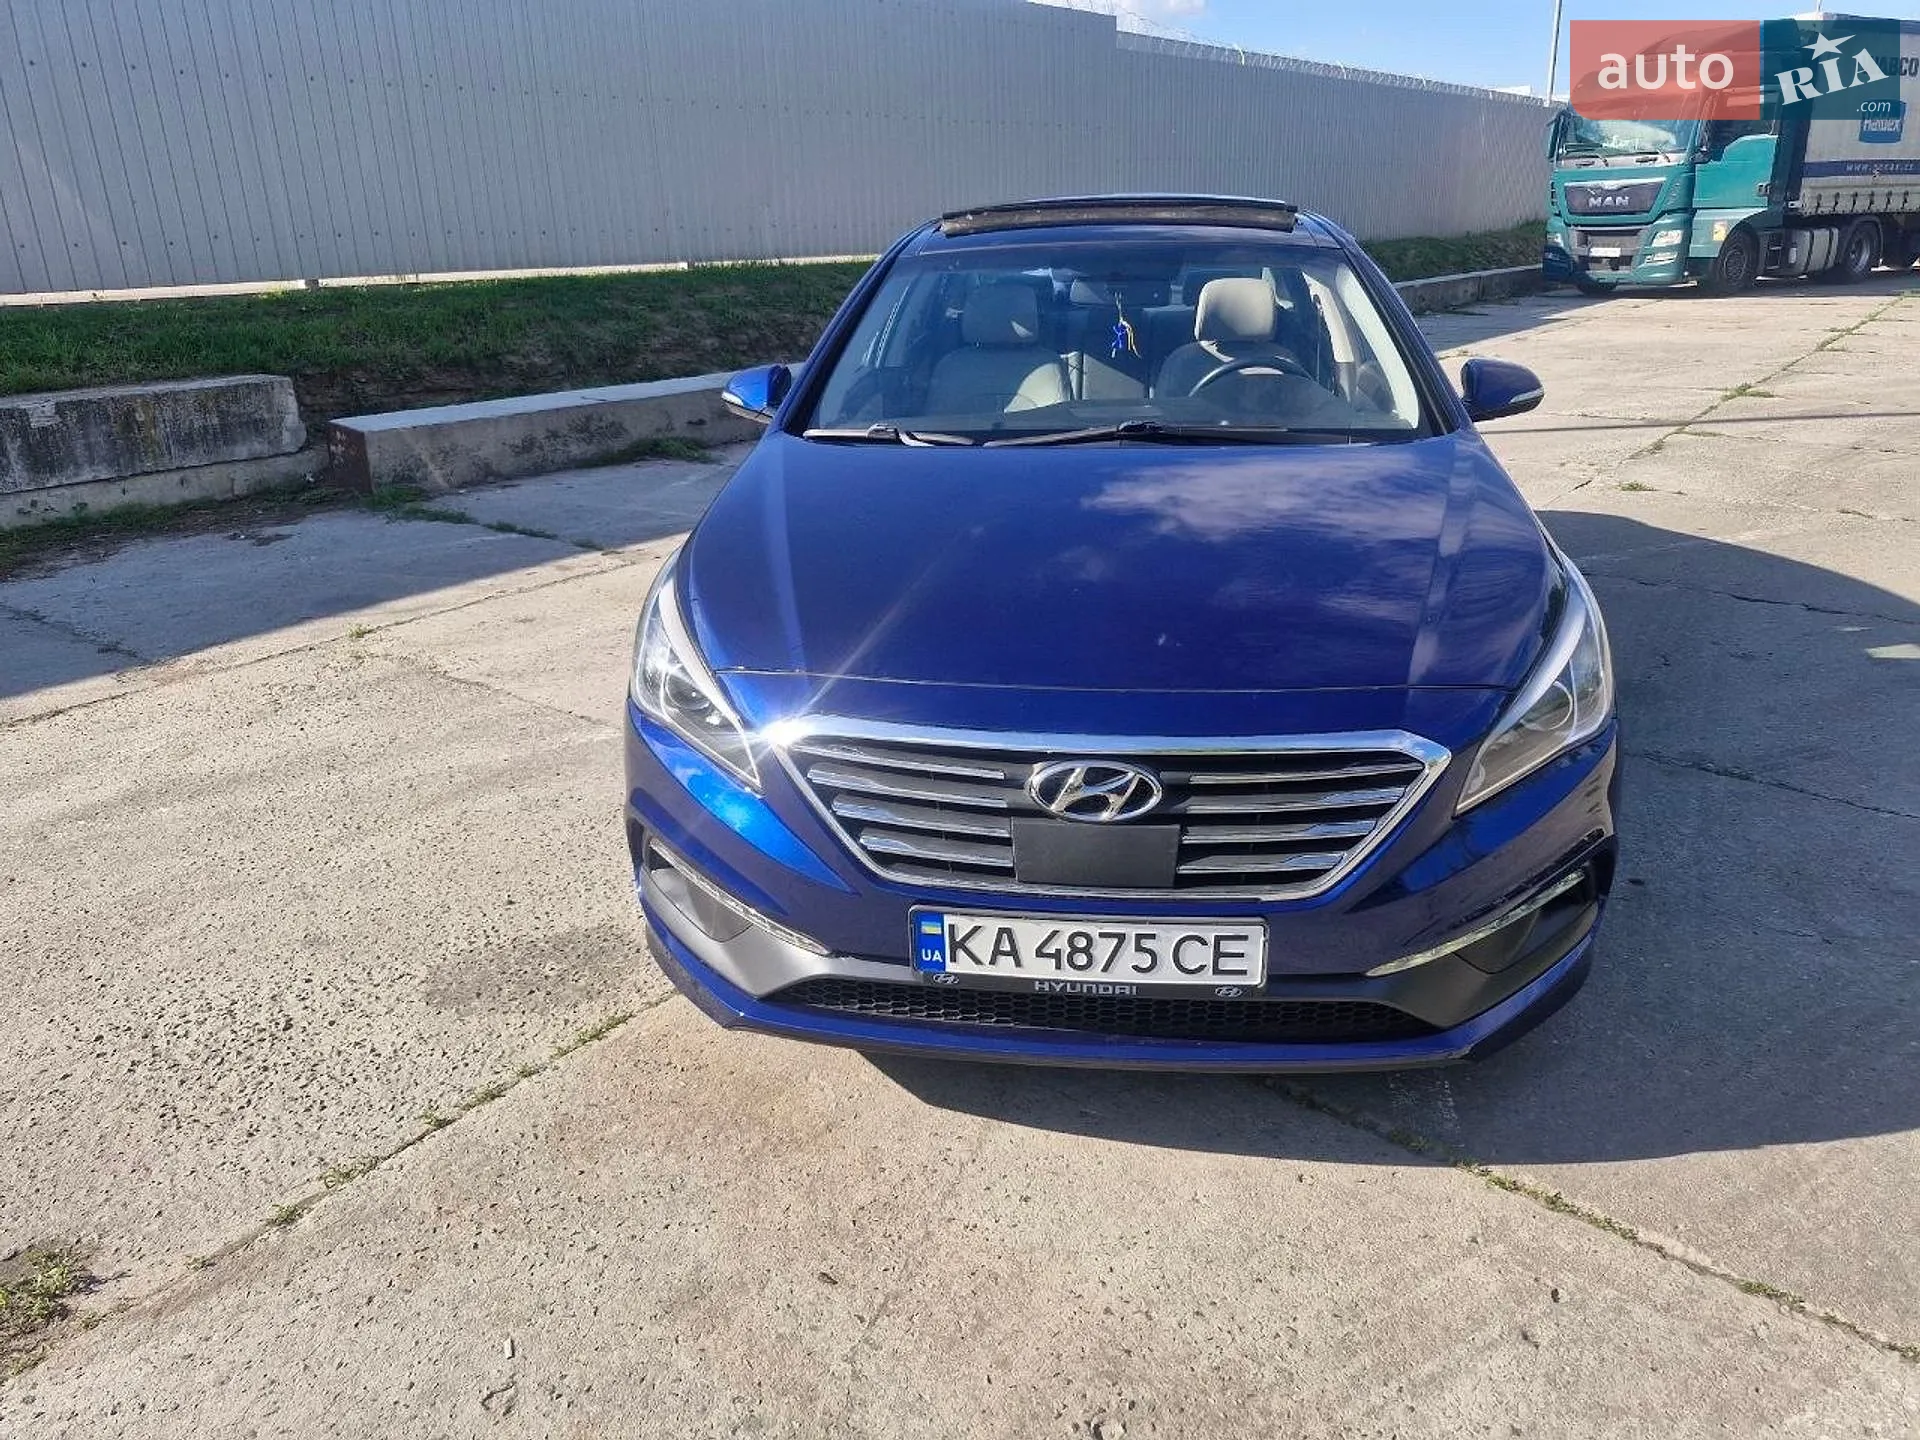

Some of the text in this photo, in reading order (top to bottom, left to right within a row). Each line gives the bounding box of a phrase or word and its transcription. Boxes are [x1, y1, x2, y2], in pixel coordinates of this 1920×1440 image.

[1864, 55, 1920, 77] ABCO
[1588, 196, 1630, 208] MAN
[922, 949, 943, 963] UA
[948, 923, 1249, 977] KA 4875 CE
[1034, 980, 1138, 996] HYUNDAI
